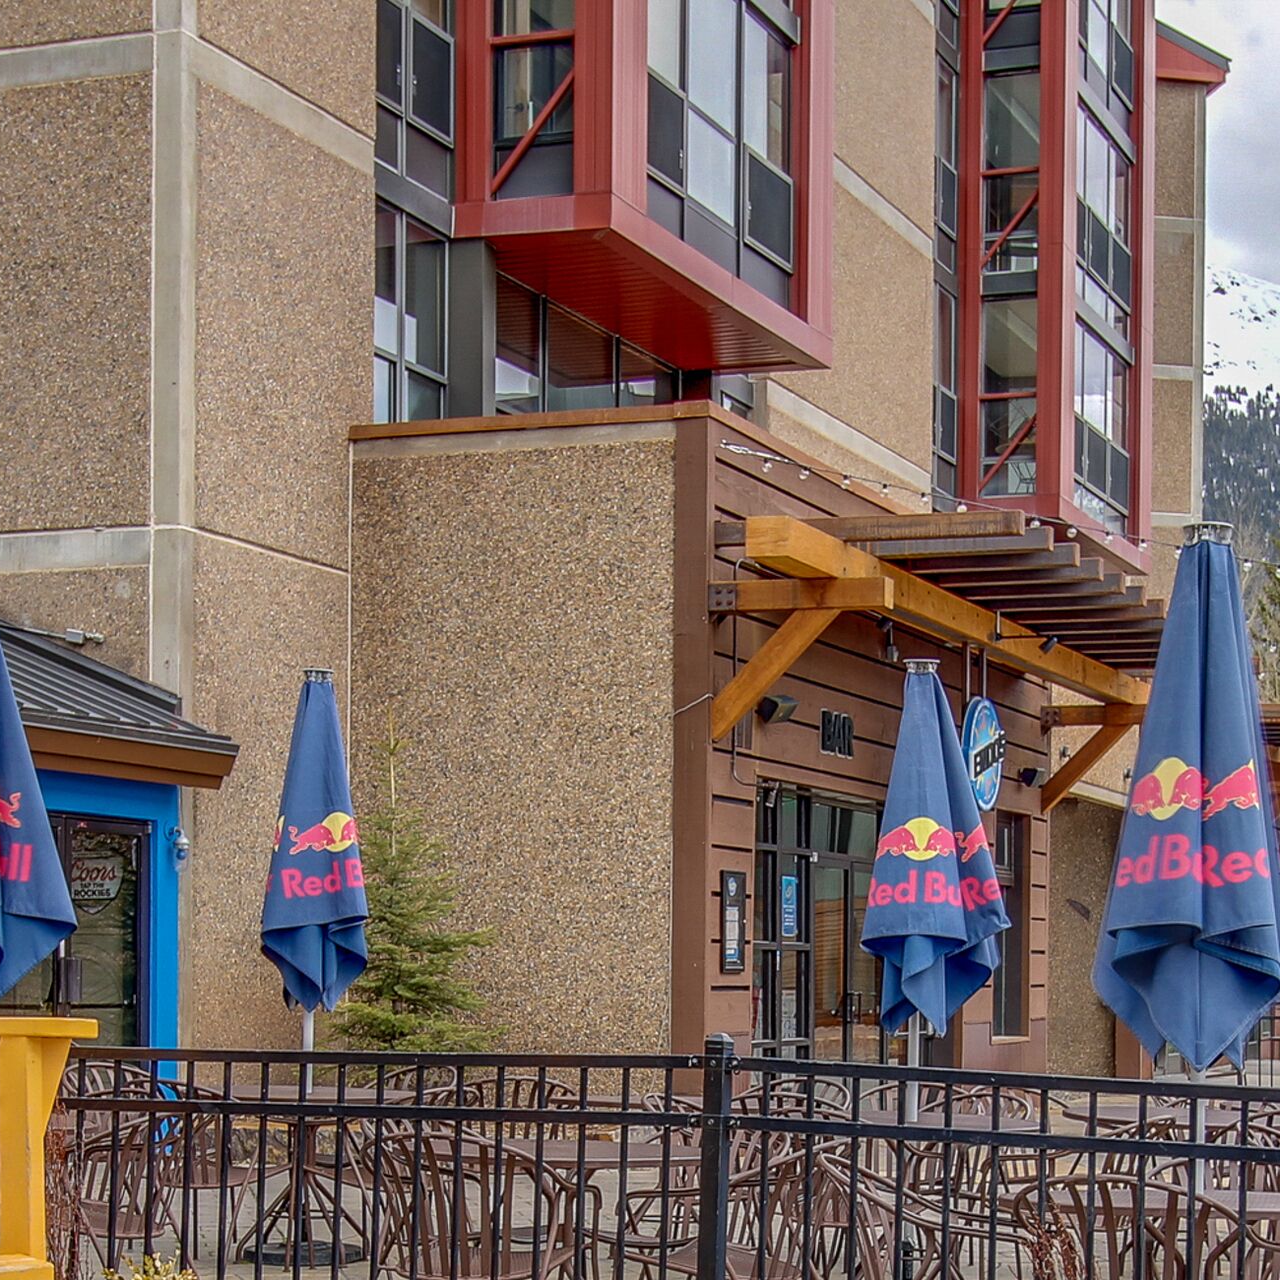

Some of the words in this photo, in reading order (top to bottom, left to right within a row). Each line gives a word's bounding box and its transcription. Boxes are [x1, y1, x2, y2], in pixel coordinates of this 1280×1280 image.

[821, 708, 854, 759] BAR
[71, 859, 118, 882] Coors
[281, 861, 343, 900] Red
[74, 889, 111, 898] ROCKIES
